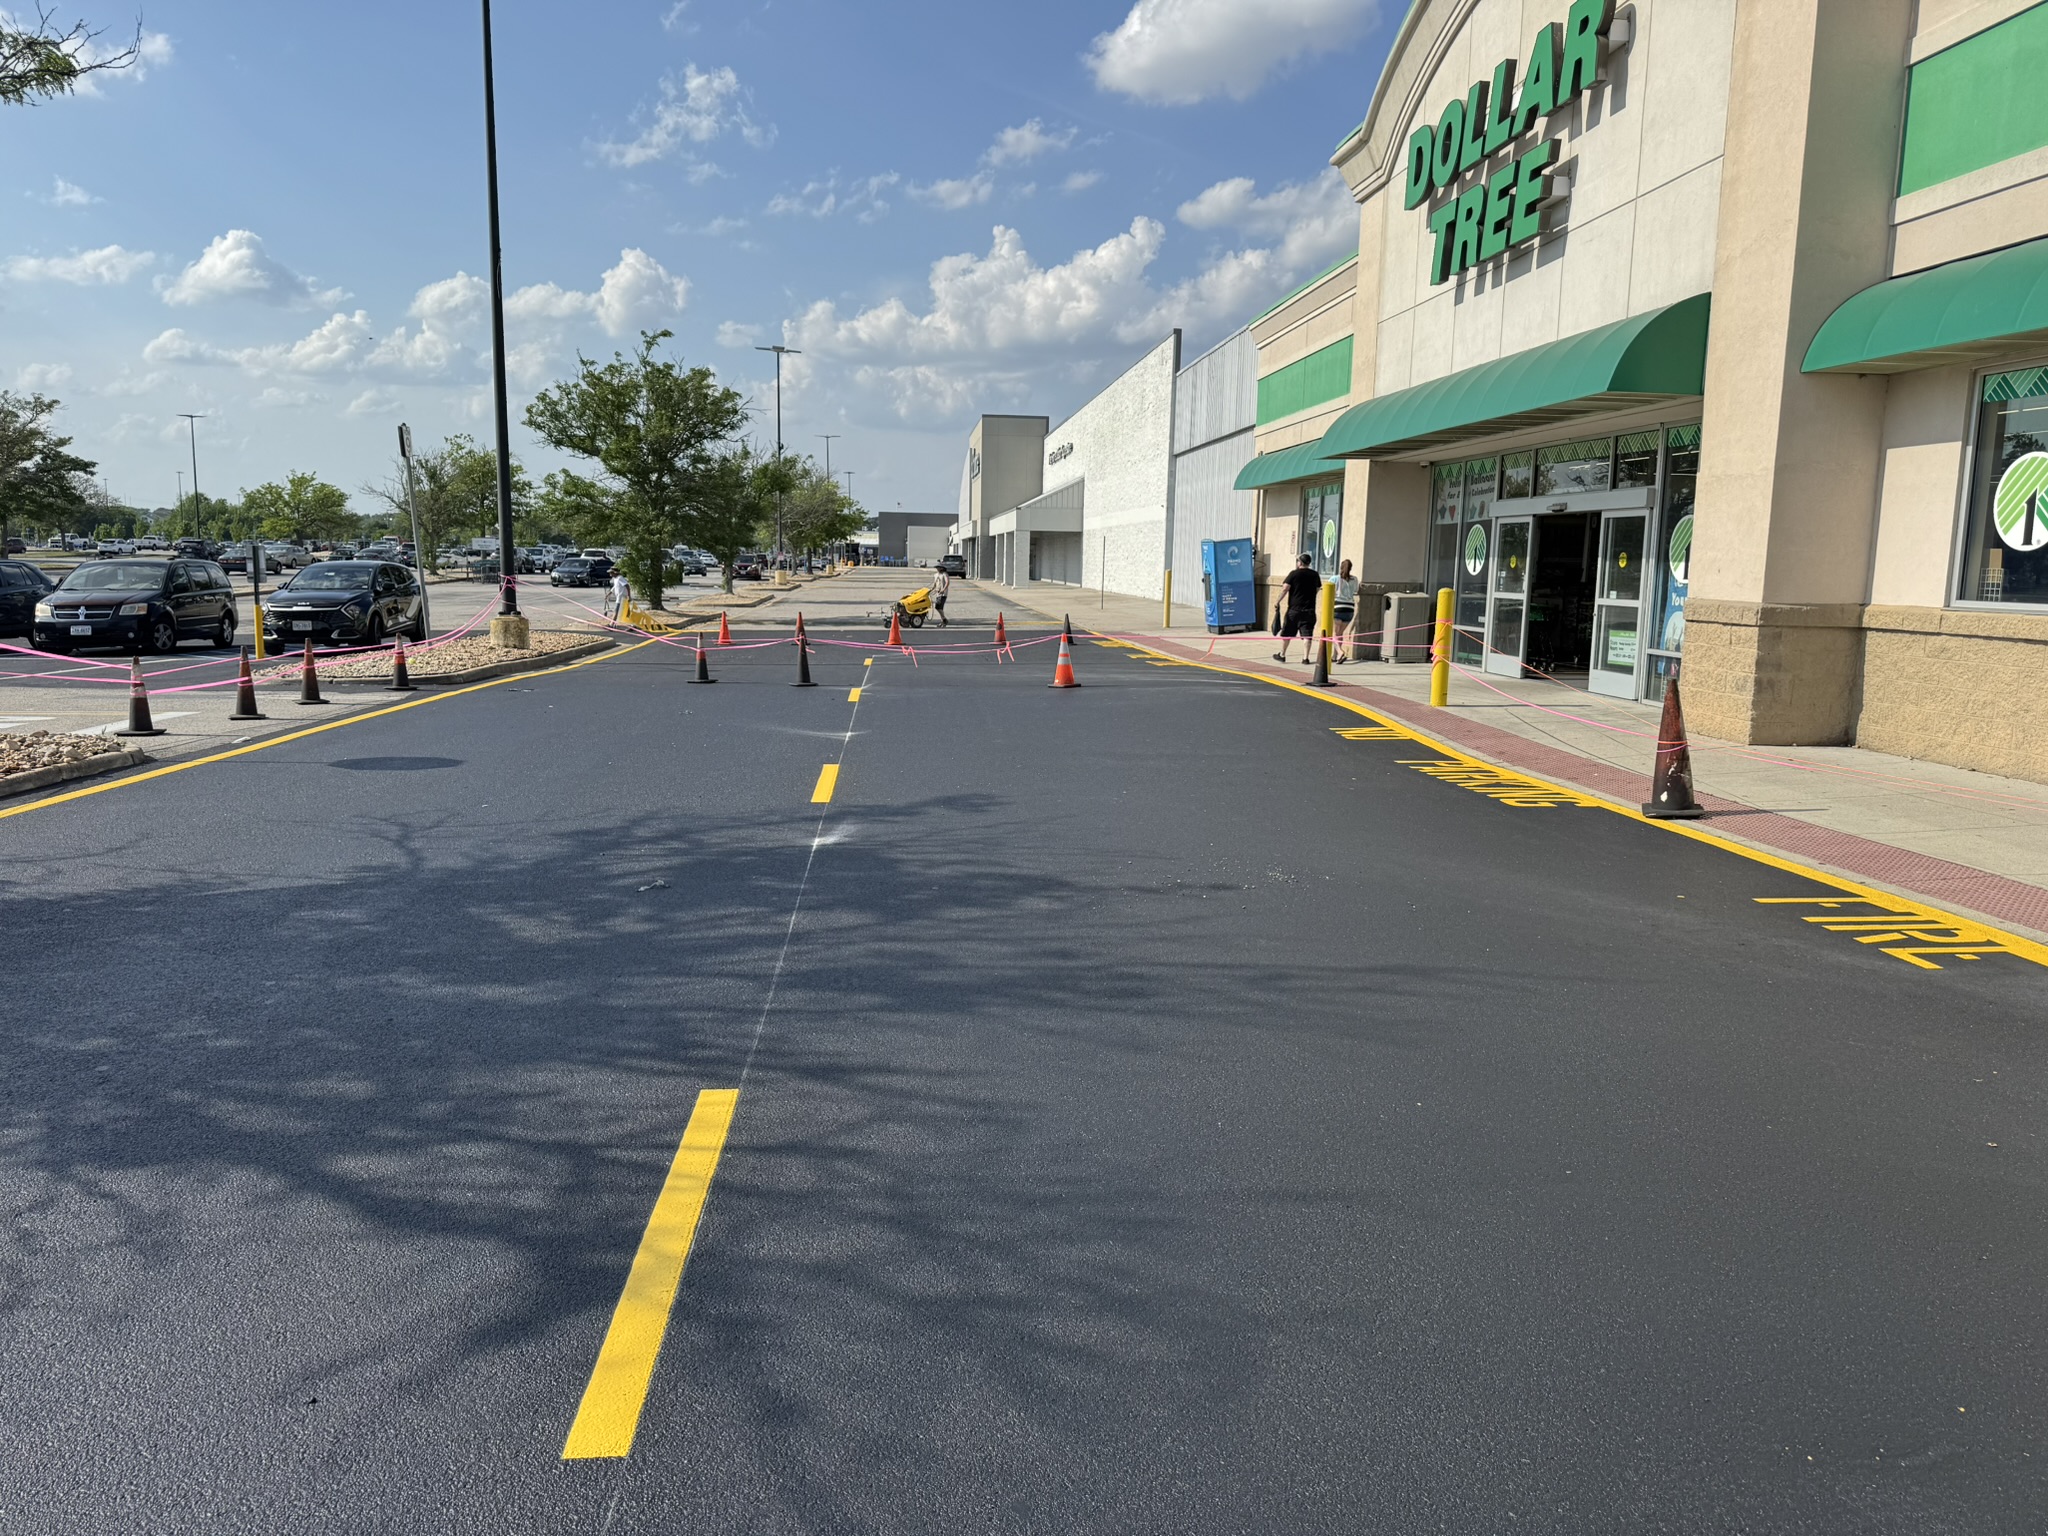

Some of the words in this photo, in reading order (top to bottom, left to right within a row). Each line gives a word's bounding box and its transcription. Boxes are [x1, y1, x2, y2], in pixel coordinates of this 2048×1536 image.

[1404, 0, 1613, 211] DOLLAR
[1430, 138, 1559, 286] TREE
[1394, 760, 1604, 808] PARKING
[1752, 897, 2018, 970] FIRE
